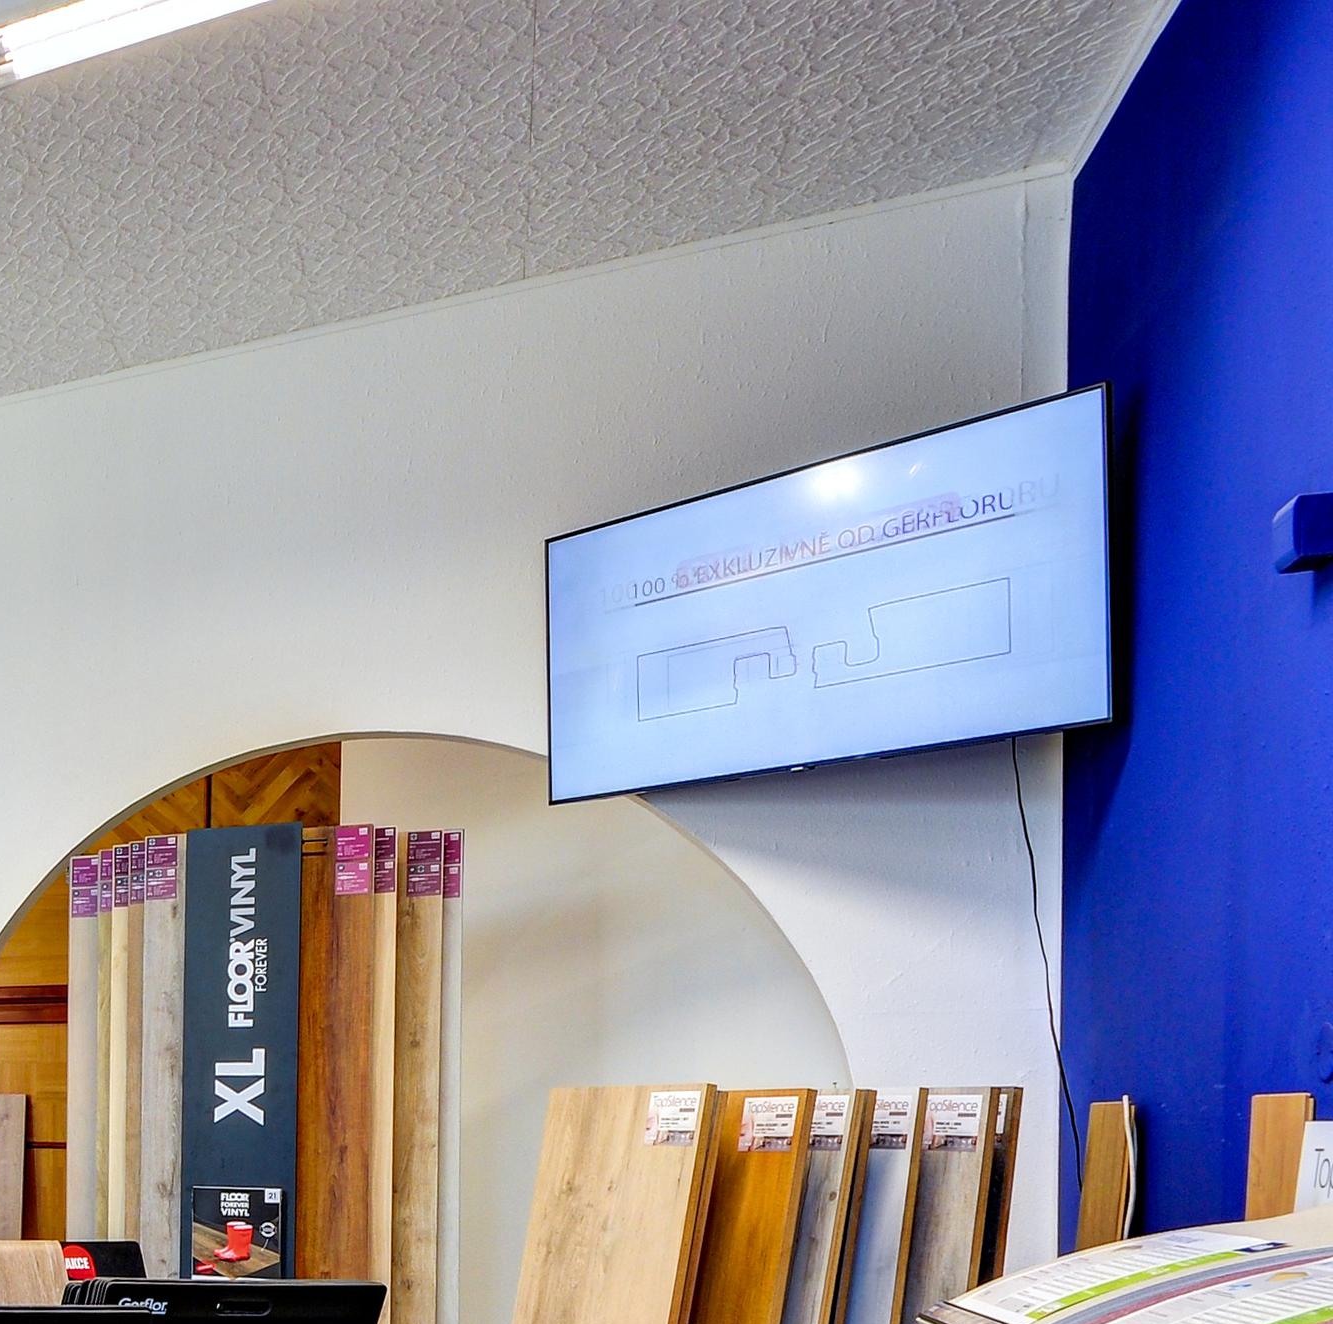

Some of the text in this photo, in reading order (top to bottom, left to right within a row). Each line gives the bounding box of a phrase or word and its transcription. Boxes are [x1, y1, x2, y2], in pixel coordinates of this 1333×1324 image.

[227, 847, 257, 1028] FLOOR VINYL
[255, 938, 268, 992] FOREVER
[213, 1048, 266, 1126] XL
[220, 1192, 250, 1202] FLOOR
[268, 1192, 277, 1200] 21
[220, 1201, 250, 1209] FOREVER
[220, 1208, 250, 1217] VINYL
